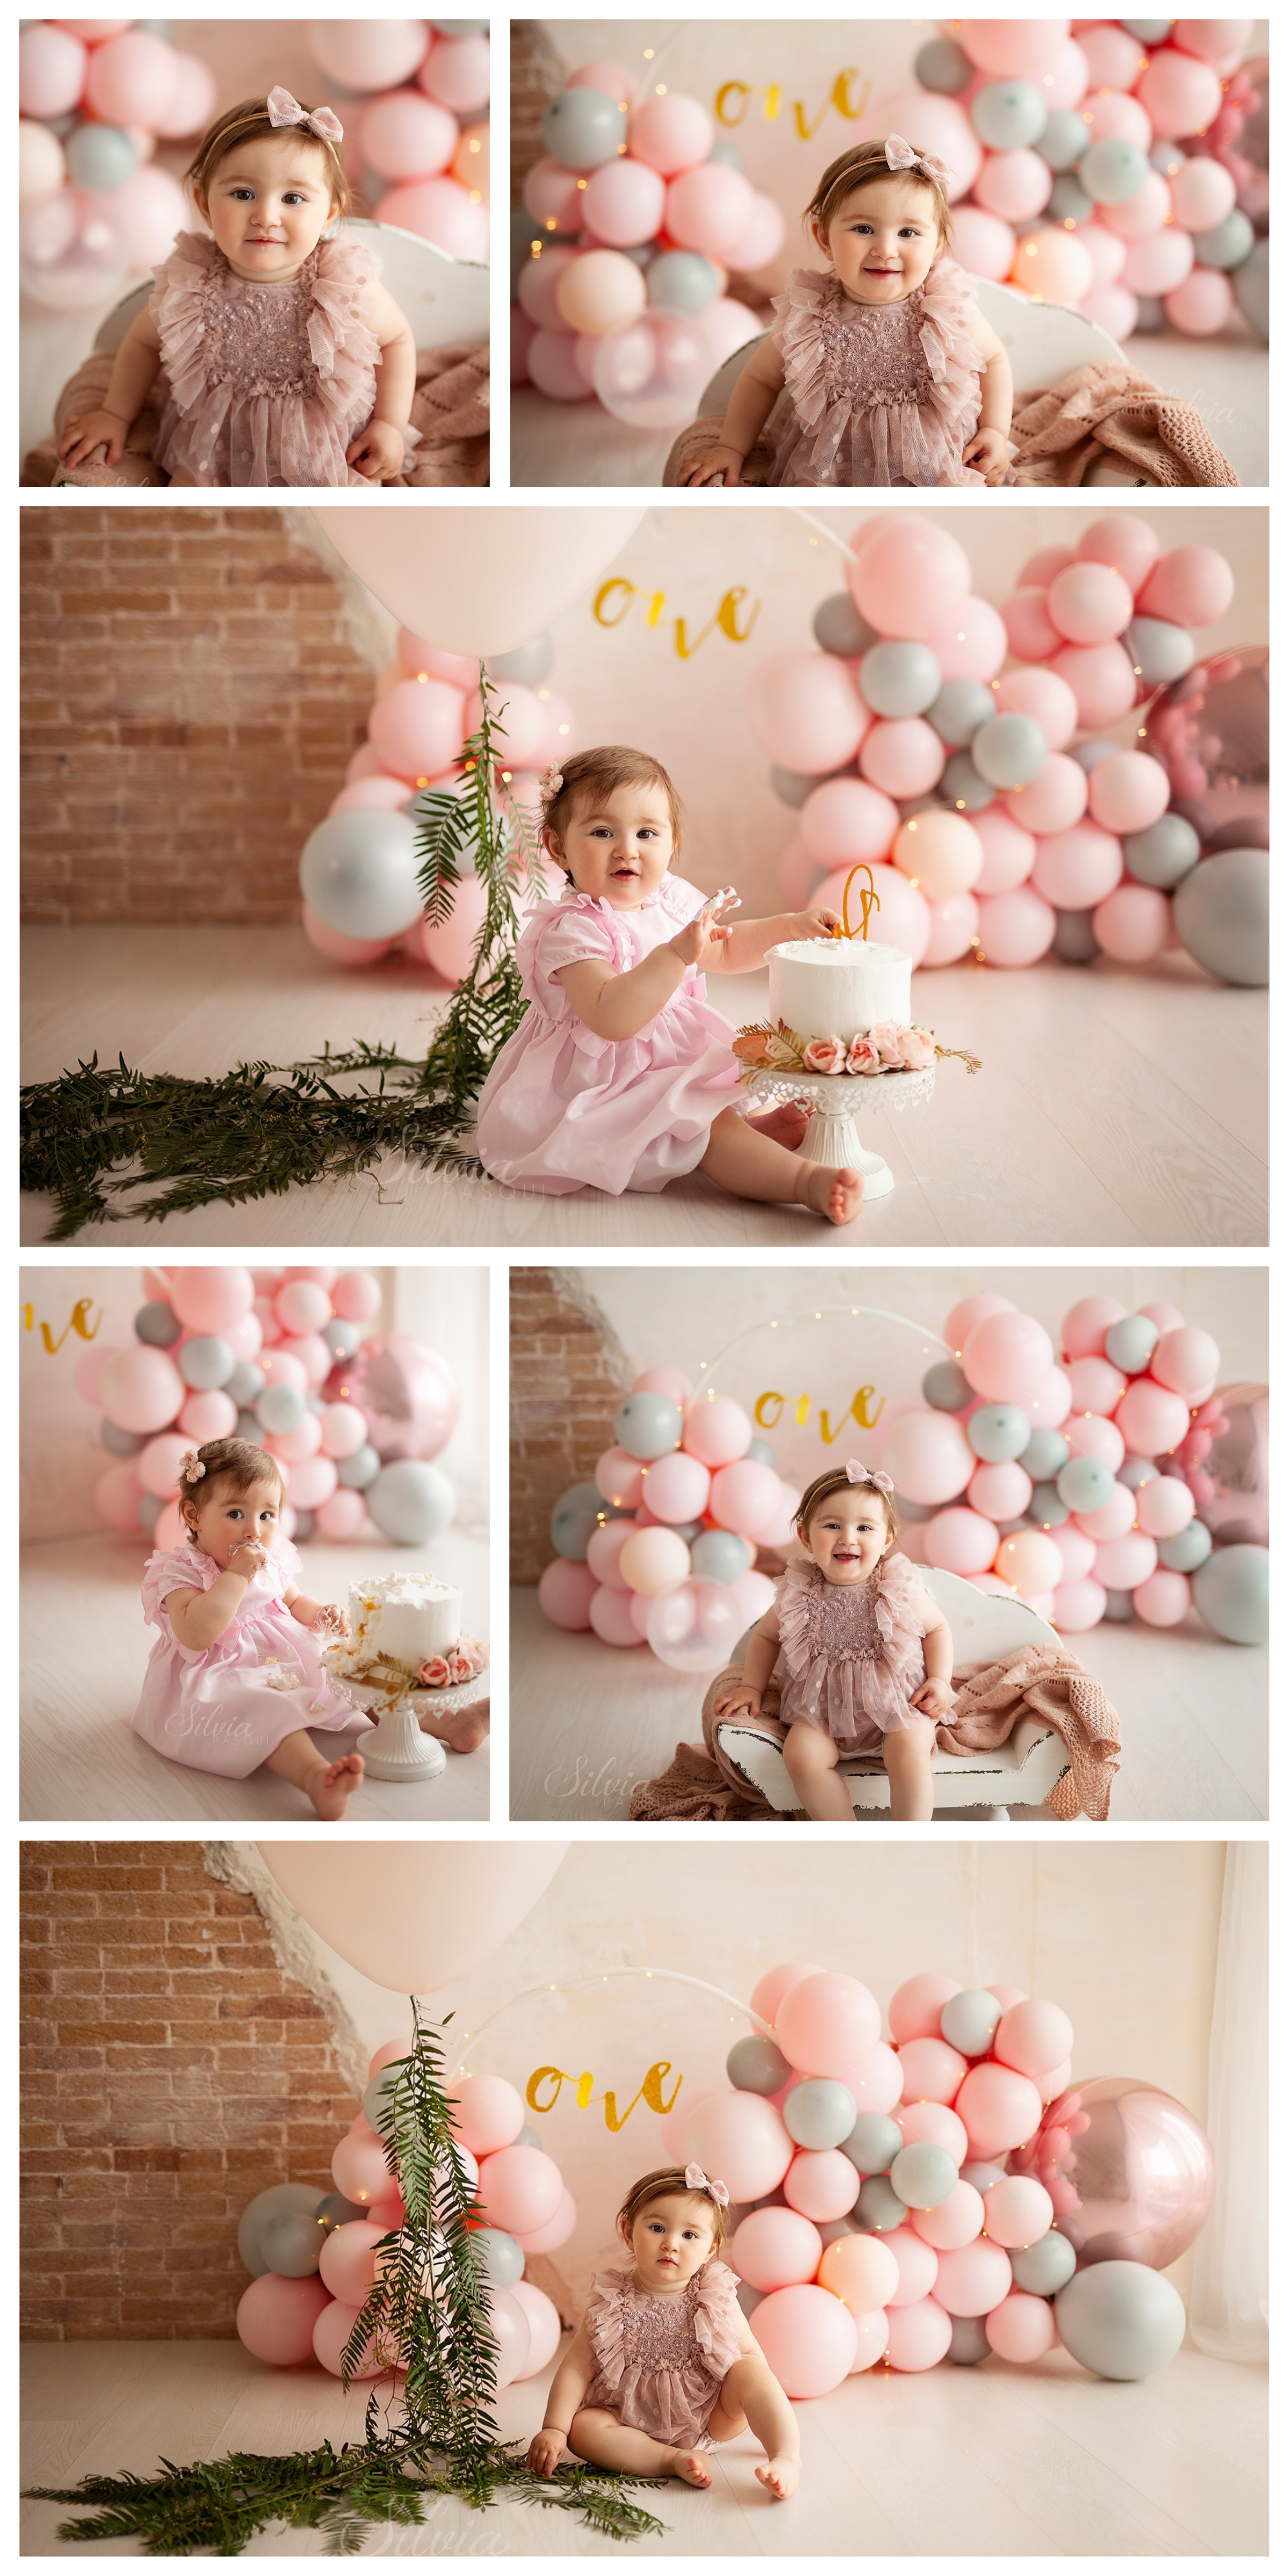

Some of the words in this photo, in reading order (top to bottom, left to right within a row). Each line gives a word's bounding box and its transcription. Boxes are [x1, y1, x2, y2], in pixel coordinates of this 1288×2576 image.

[714, 67, 873, 141] one
[591, 577, 762, 659] one
[753, 1385, 886, 1444] one
[526, 2061, 683, 2133] one
